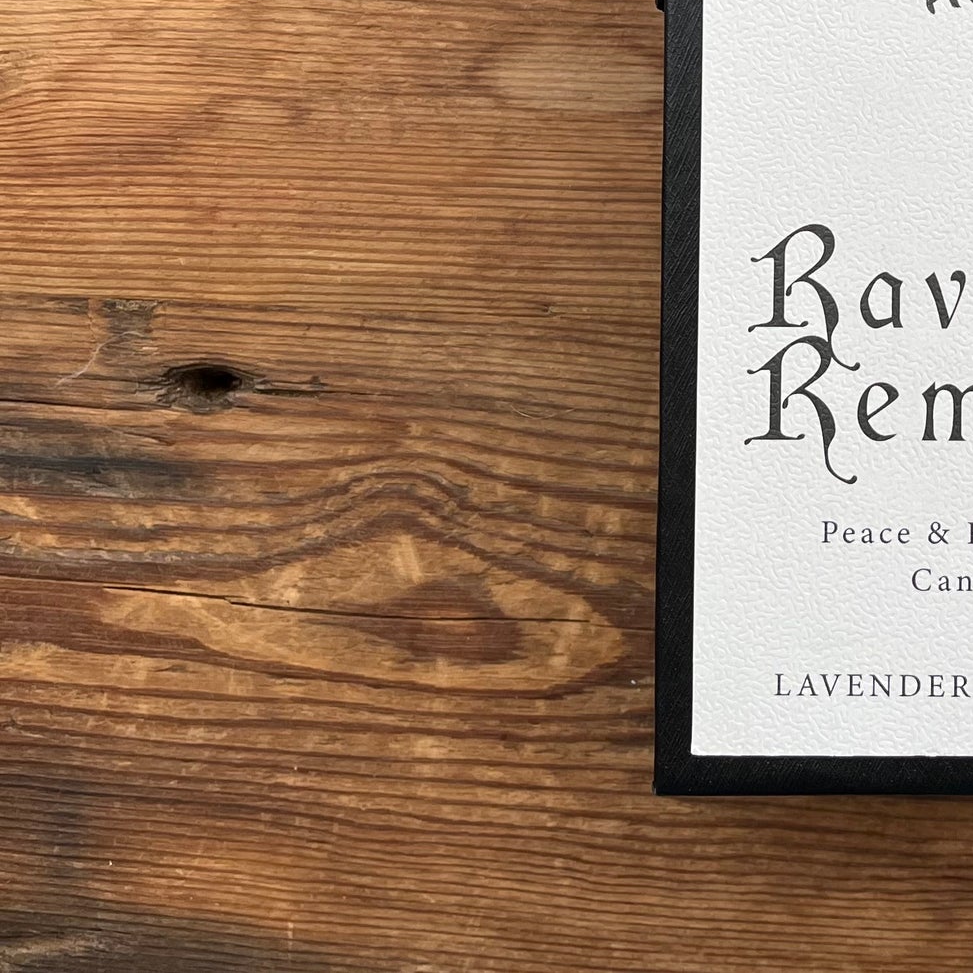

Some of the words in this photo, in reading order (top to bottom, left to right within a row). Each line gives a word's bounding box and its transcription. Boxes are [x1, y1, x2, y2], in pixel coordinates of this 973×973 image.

[821, 520, 911, 545] Peace
[926, 521, 951, 546] &
[774, 672, 972, 698] LAVENDER
